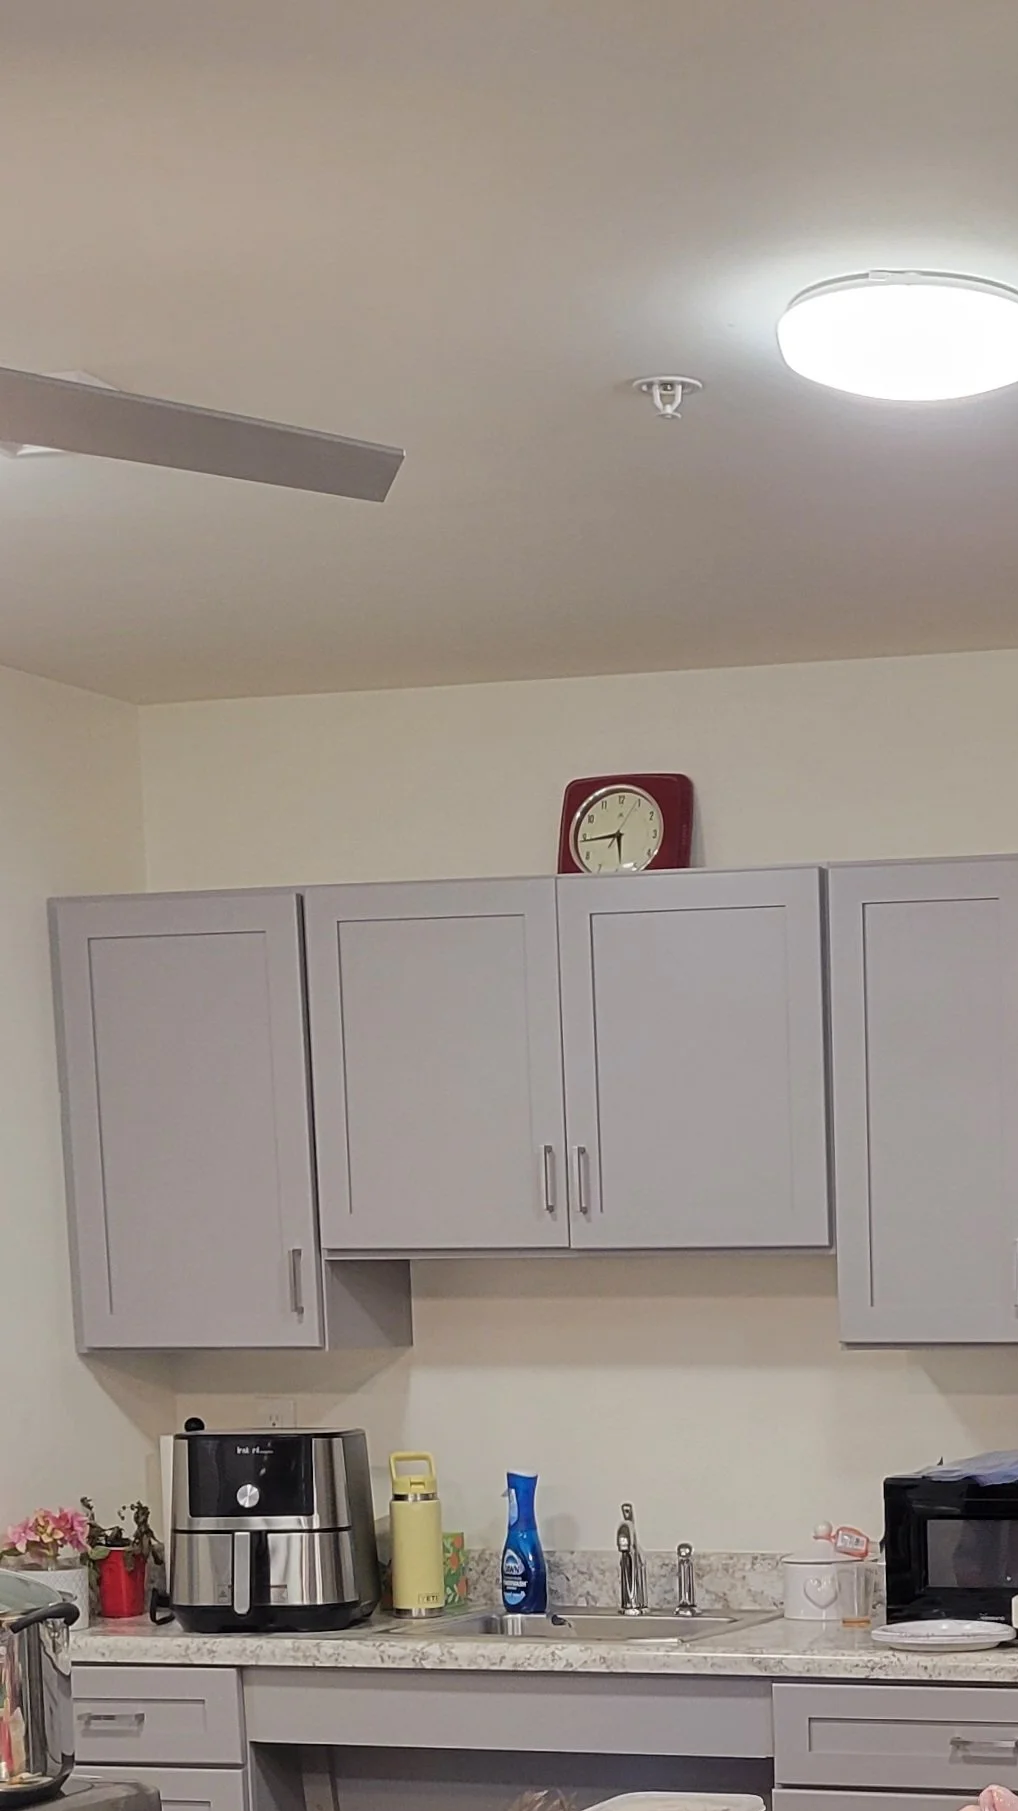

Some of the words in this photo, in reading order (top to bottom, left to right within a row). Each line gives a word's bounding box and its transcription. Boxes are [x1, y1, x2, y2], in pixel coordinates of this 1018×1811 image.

[619, 795, 625, 805] 12
[601, 801, 607, 810] 11
[588, 814, 595, 824] 10
[649, 811, 654, 820] 2
[652, 829, 657, 839] 3
[585, 851, 590, 860] 8
